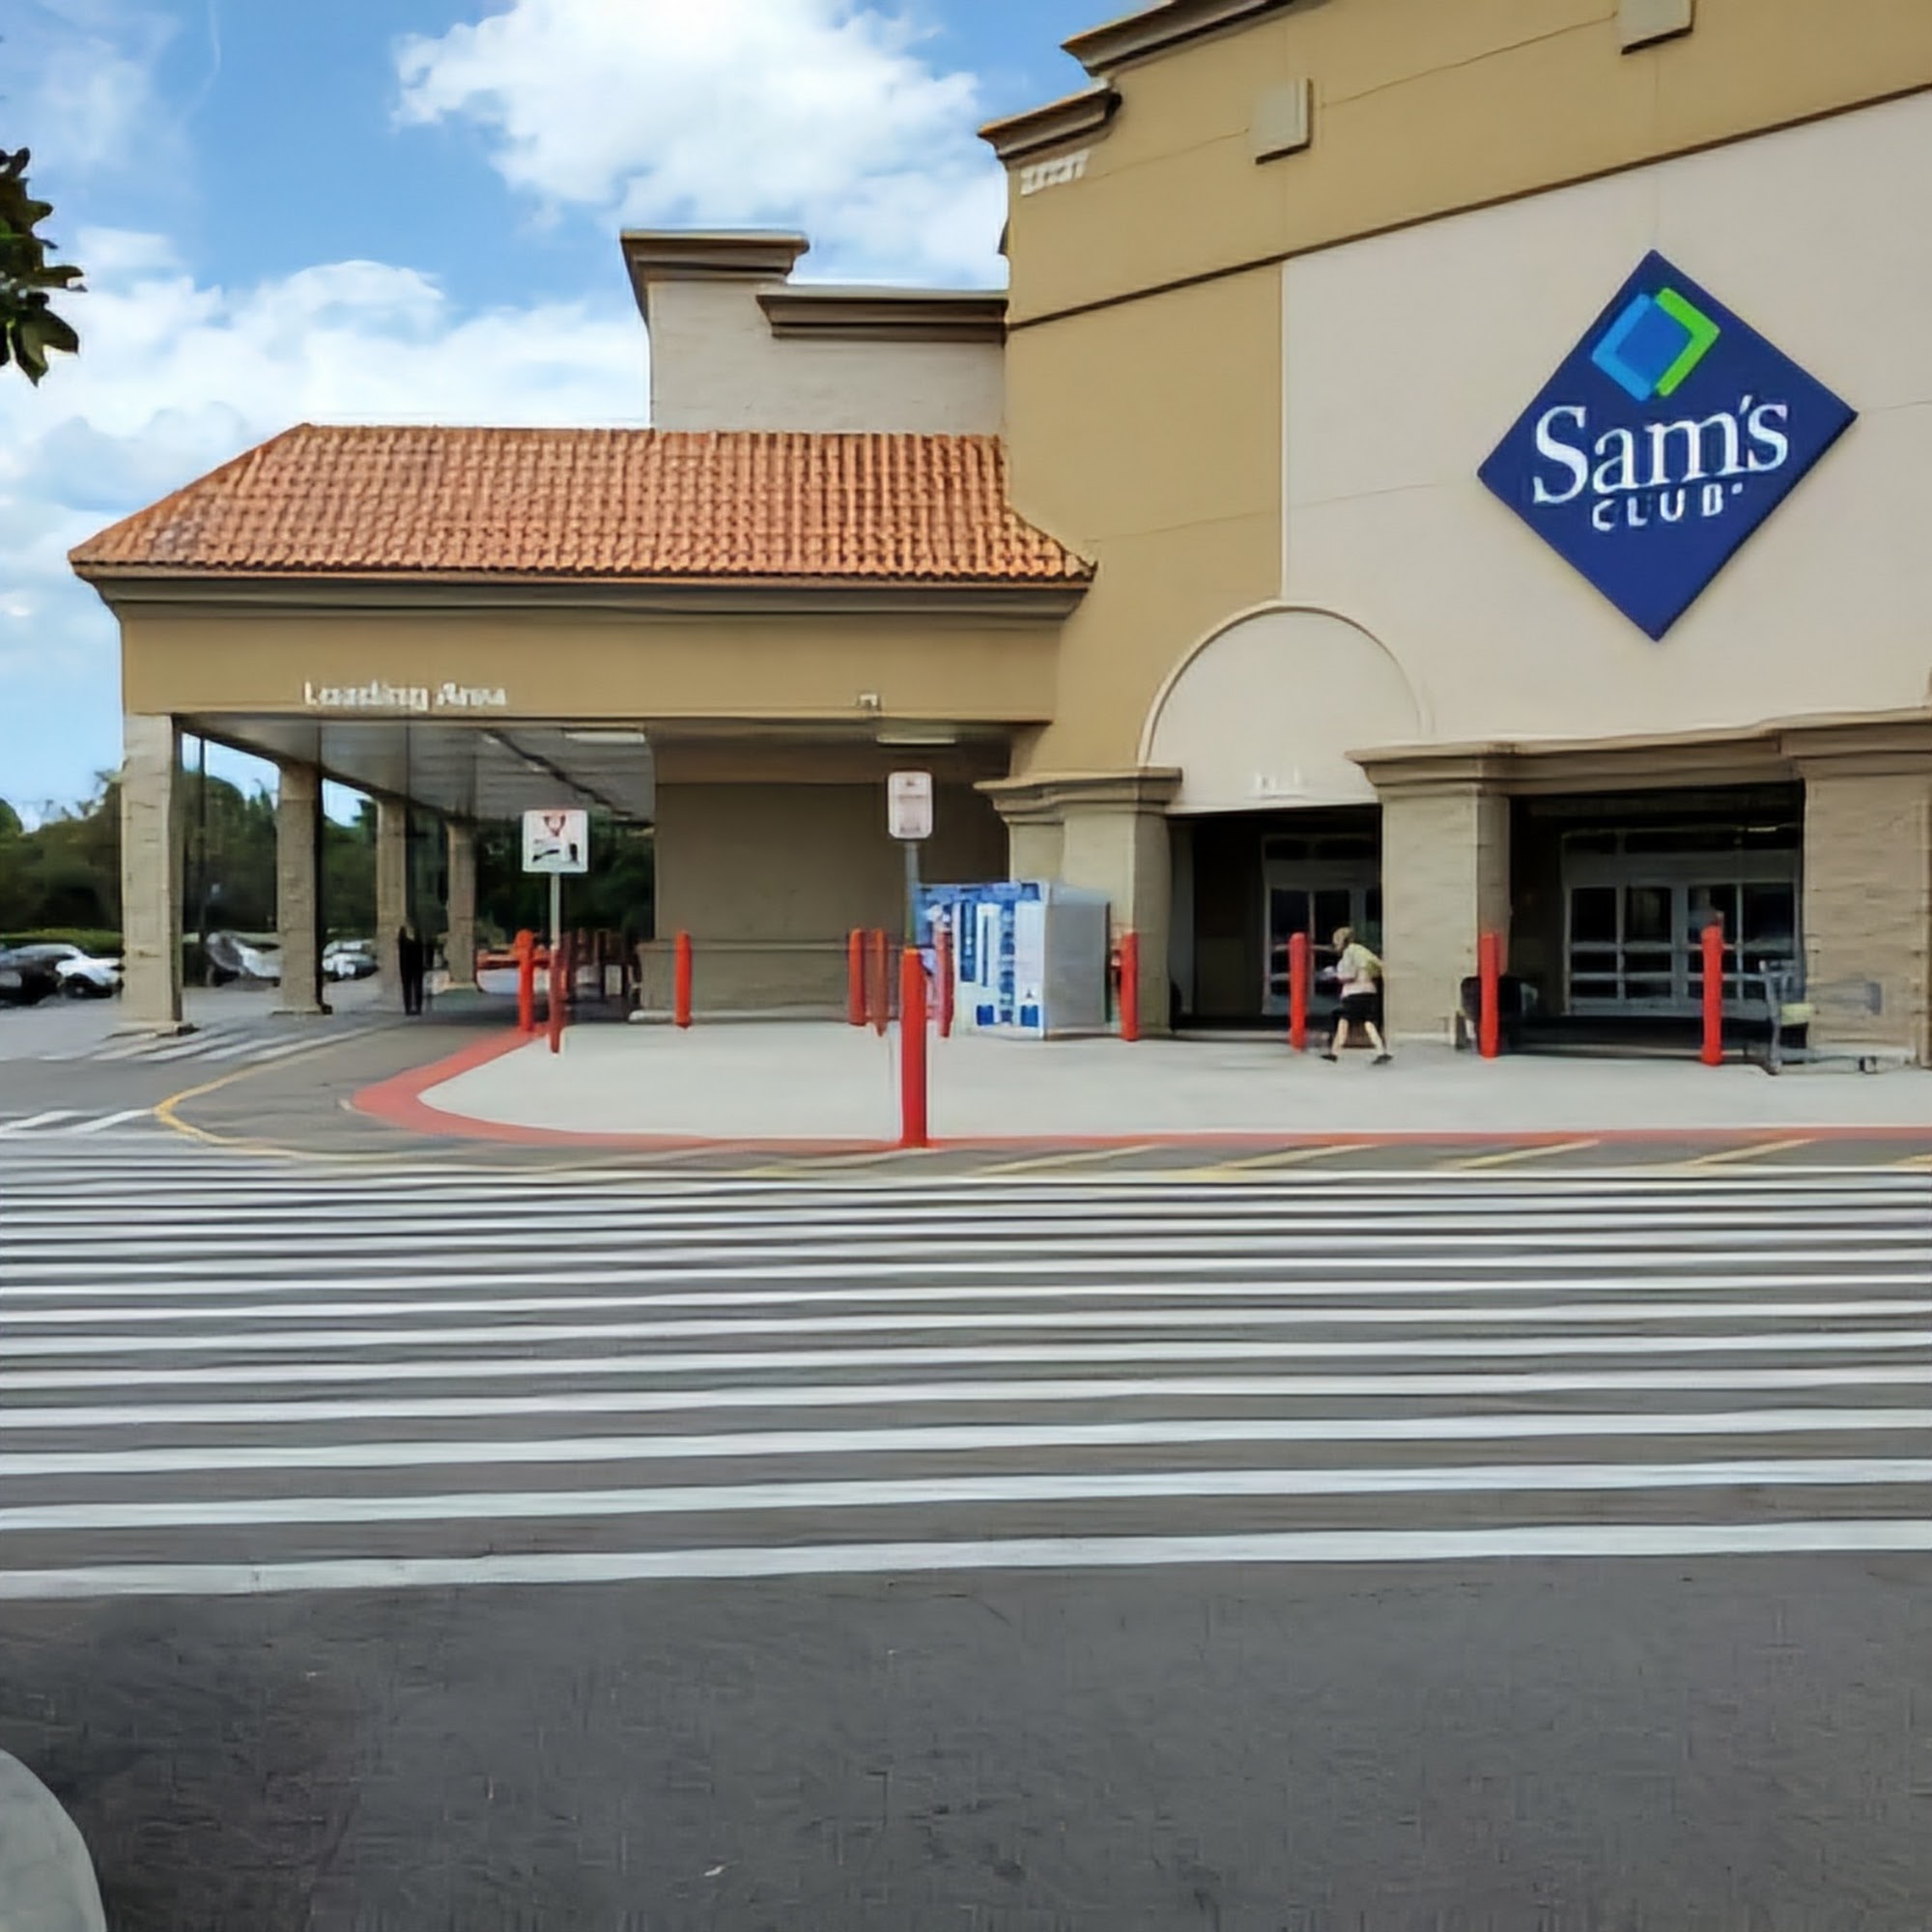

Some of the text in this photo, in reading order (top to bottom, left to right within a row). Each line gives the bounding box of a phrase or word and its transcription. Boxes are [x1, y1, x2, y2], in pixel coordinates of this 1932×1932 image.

[1533, 394, 1788, 503] Sam's
[1592, 484, 1724, 531] CLUB
[304, 679, 429, 710] Loading
